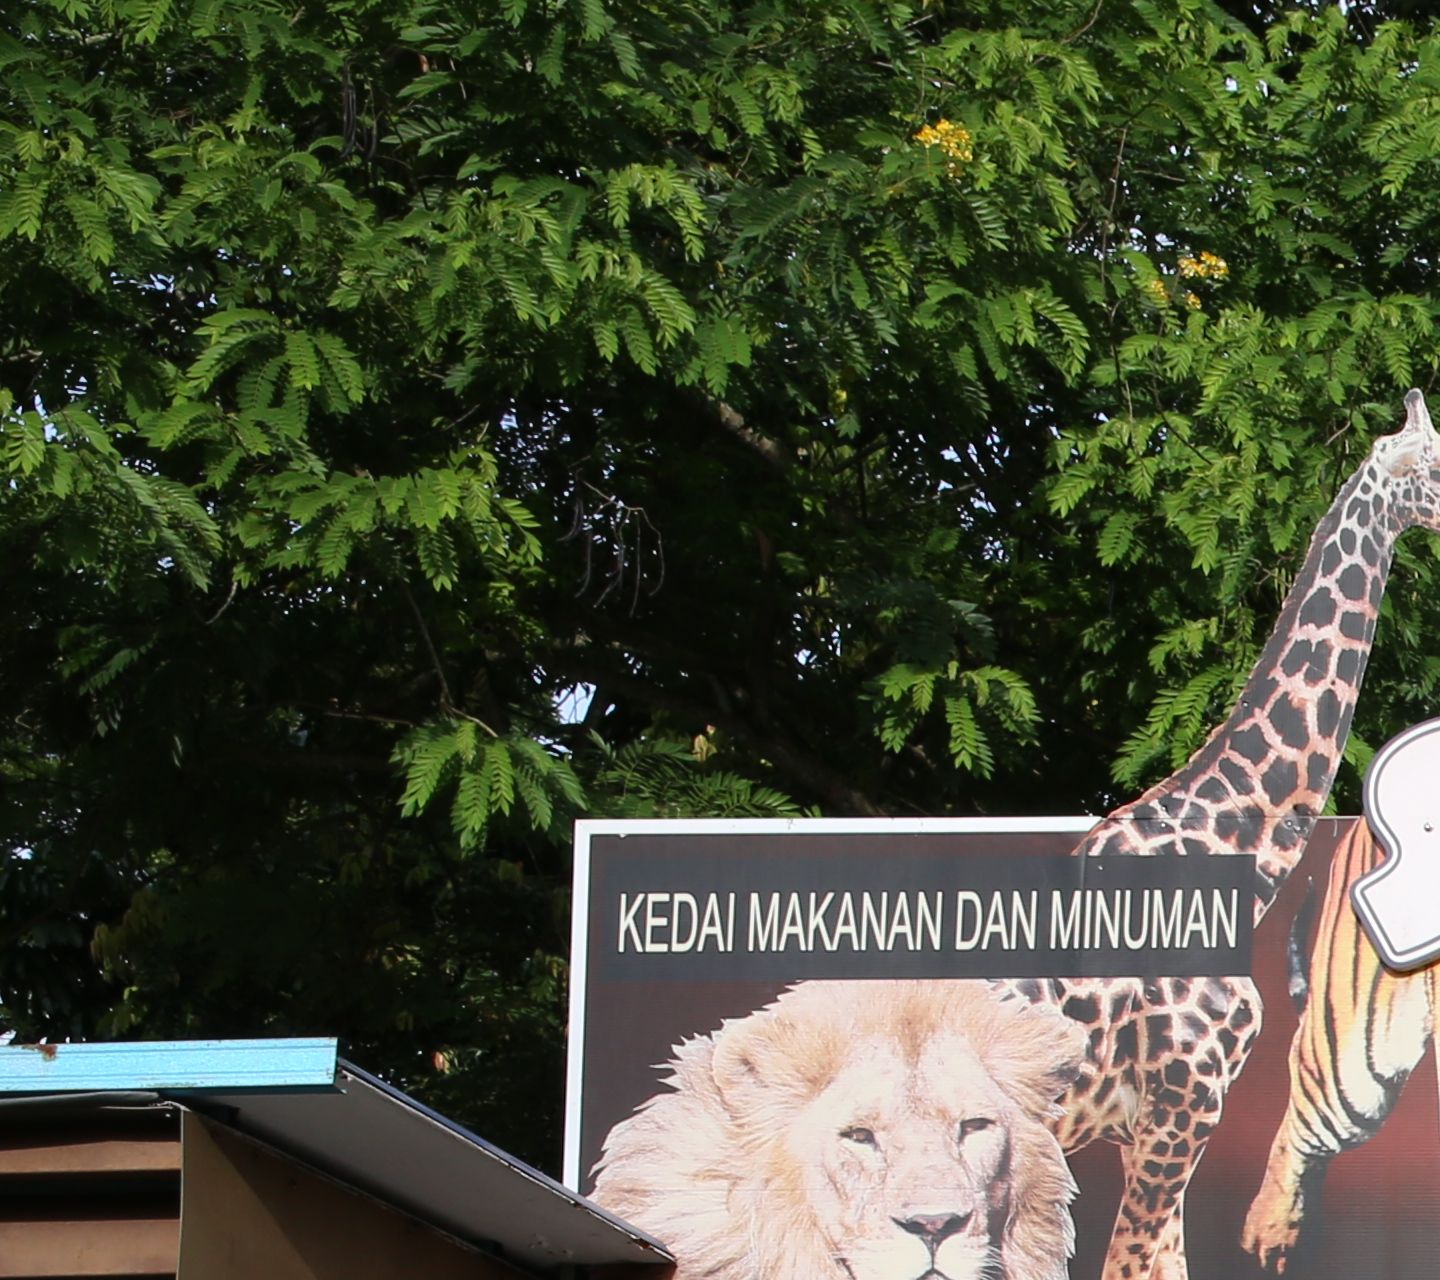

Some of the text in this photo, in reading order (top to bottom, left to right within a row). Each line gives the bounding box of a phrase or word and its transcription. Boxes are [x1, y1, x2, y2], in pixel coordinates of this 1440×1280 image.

[617, 887, 1239, 954] KEDAI MAKANAN DAN MINUMAN
